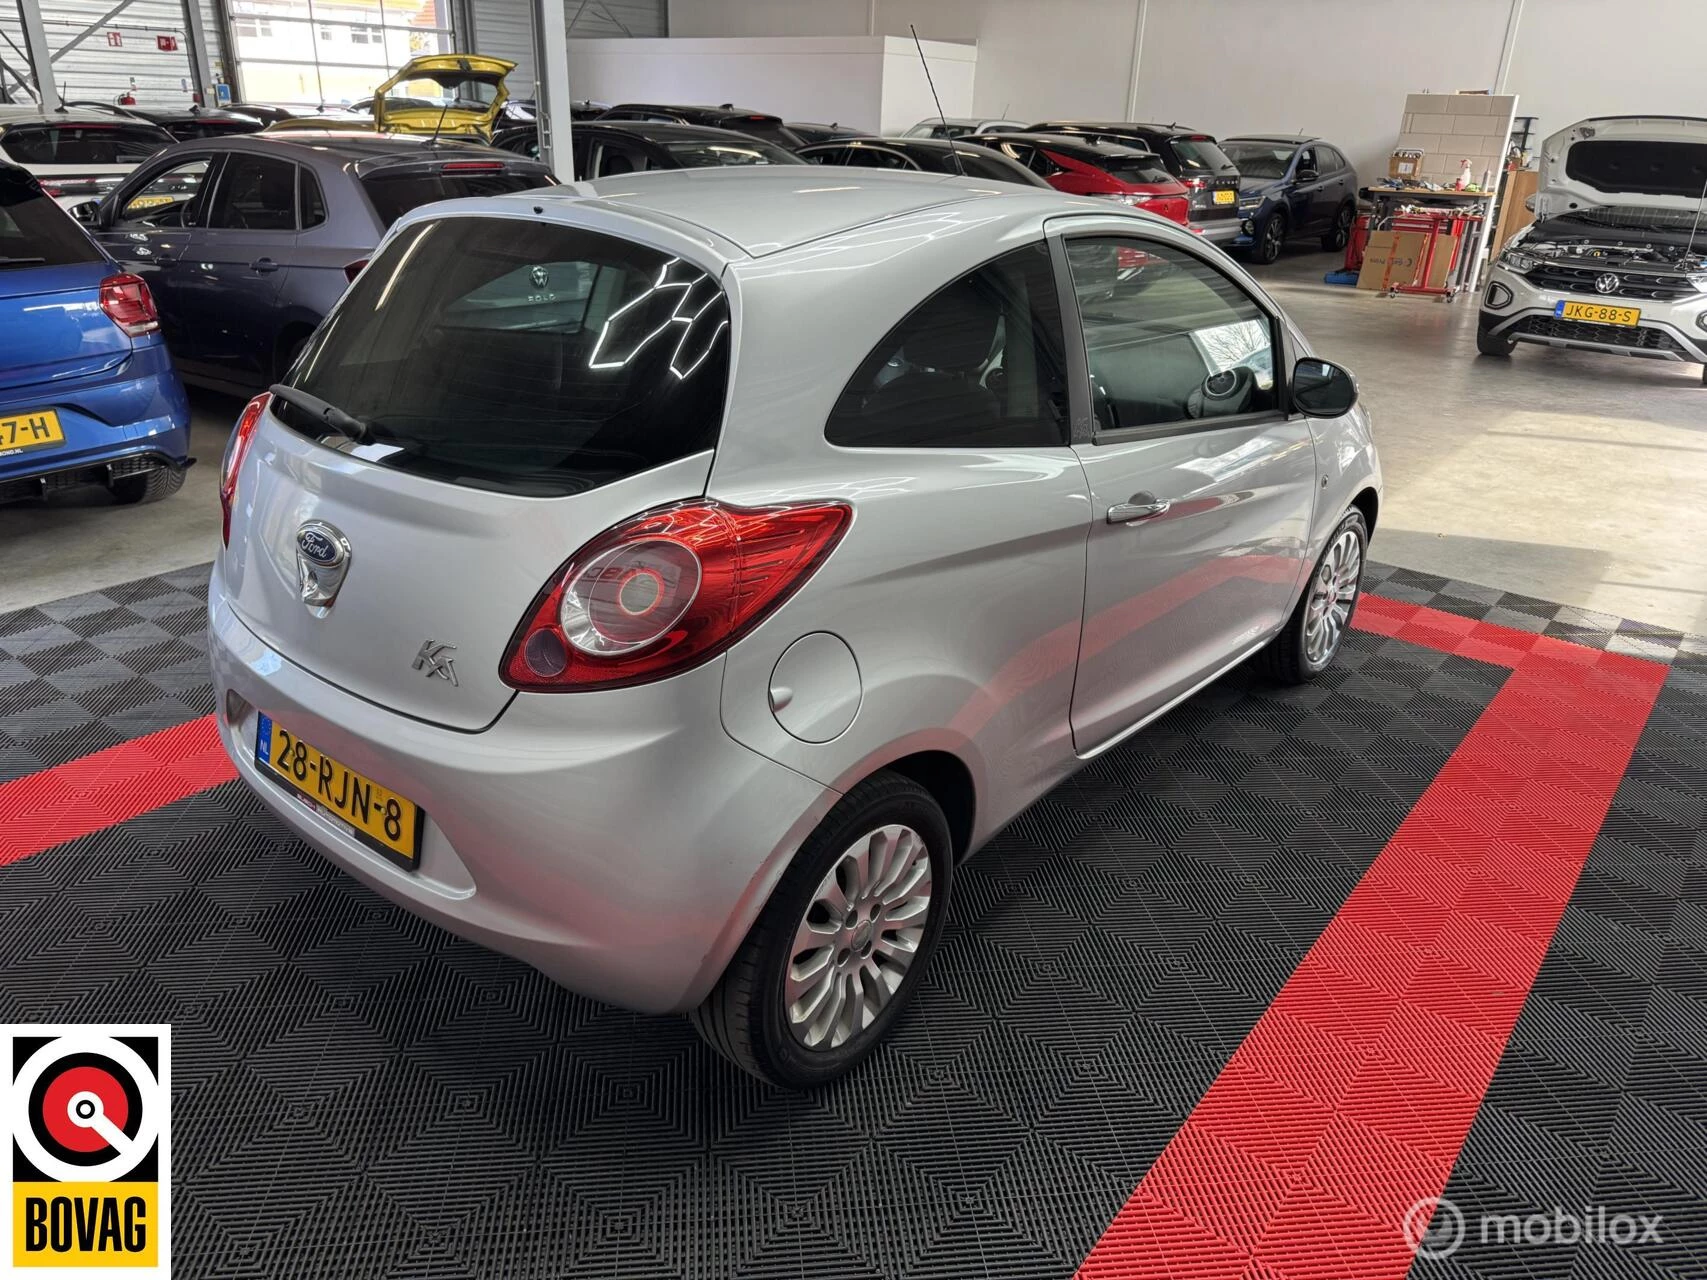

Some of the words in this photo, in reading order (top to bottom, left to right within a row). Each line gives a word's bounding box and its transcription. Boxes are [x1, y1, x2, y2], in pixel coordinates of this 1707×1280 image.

[1566, 304, 1632, 322] JKG-88-S
[301, 532, 328, 559] Ford
[277, 728, 402, 842] 28-RJN-8
